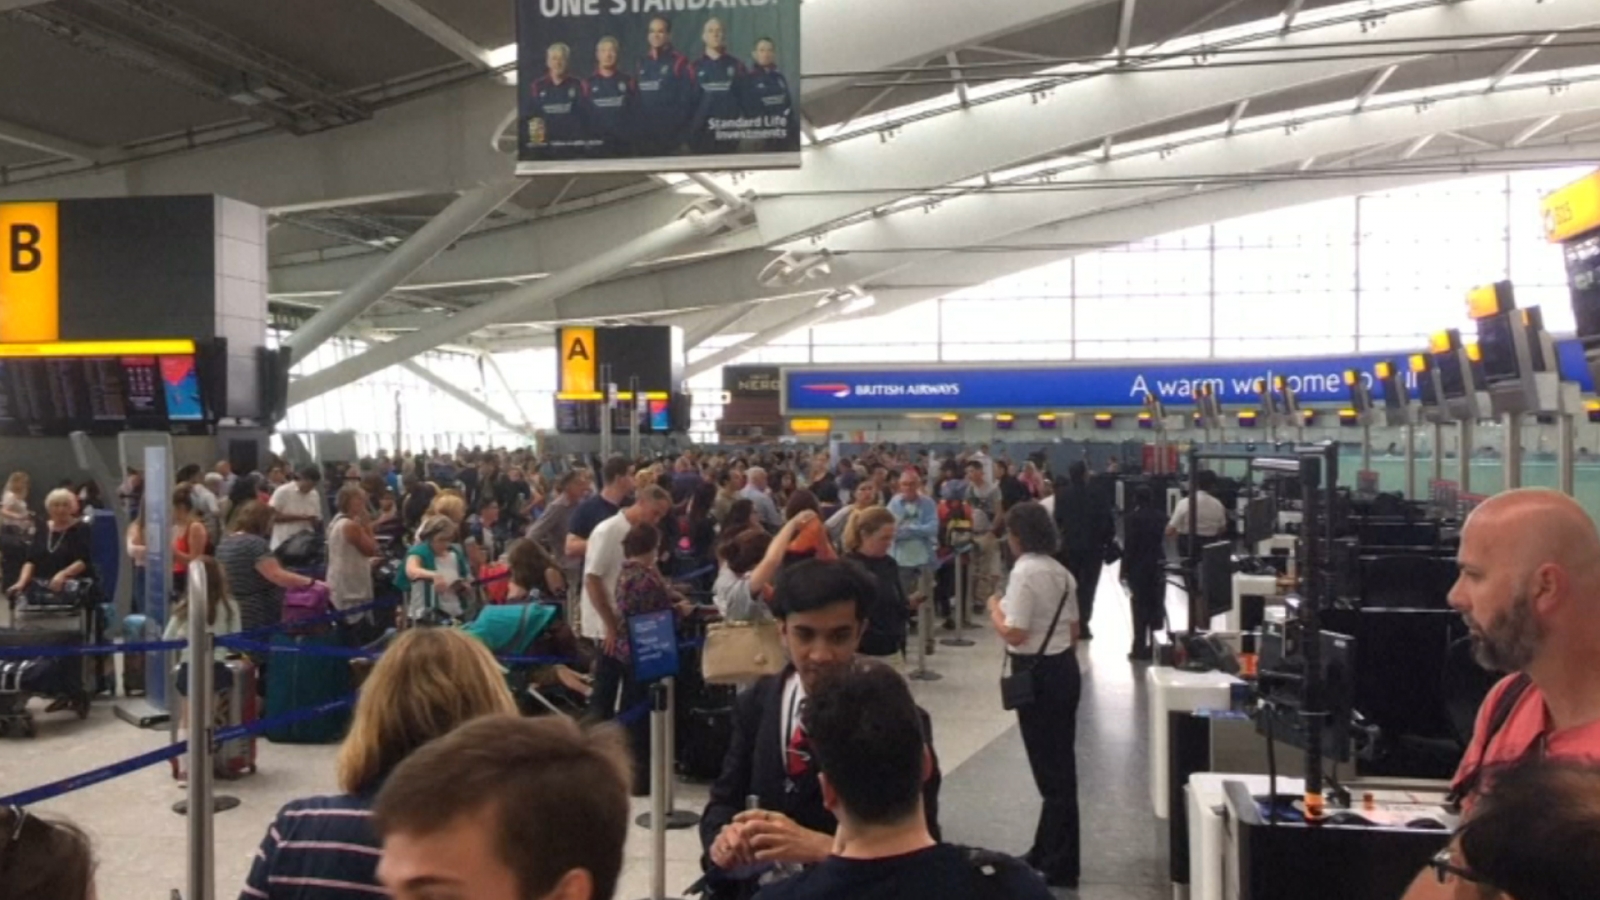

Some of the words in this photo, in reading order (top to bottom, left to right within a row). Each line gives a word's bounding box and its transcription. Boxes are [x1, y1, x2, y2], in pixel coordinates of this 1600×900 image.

[539, 0, 600, 17] ONE
[708, 115, 762, 130] Standard
[764, 115, 787, 127] Life
[715, 129, 787, 140] Investments
[10, 223, 42, 273] B
[567, 337, 590, 360] A
[855, 384, 905, 396] BRITISH
[906, 383, 960, 396] AIRWAYS
[1129, 374, 1151, 397] A
[1156, 378, 1224, 397] warm
[1231, 369, 1341, 395] wlome
